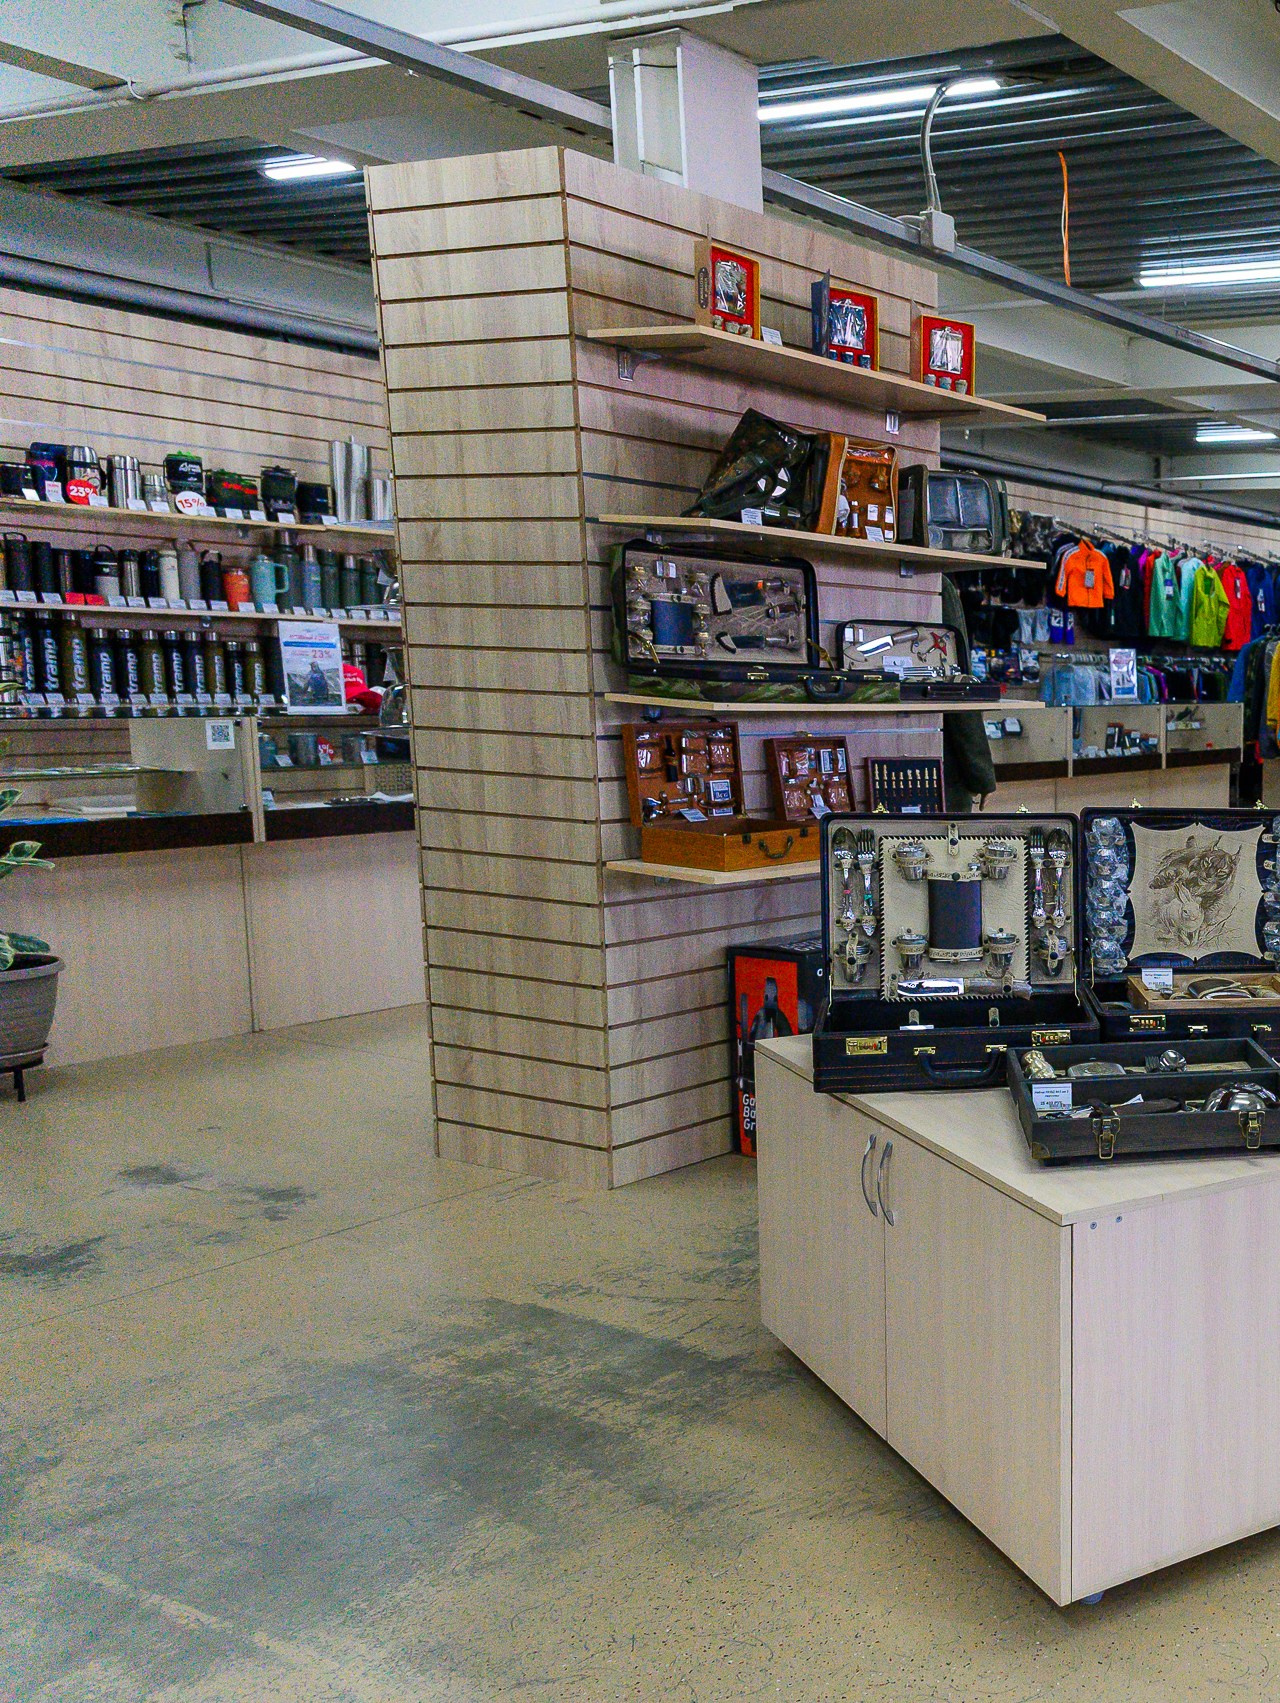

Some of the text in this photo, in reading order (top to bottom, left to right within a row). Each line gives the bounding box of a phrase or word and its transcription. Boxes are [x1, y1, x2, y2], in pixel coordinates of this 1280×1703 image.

[69, 486, 94, 497] 23%
[178, 498, 204, 508] 15%
[44, 637, 60, 691] tramp
[72, 637, 86, 691] tramp
[100, 651, 112, 695] tramp
[126, 650, 139, 693] tramp
[173, 650, 184, 693] tramp
